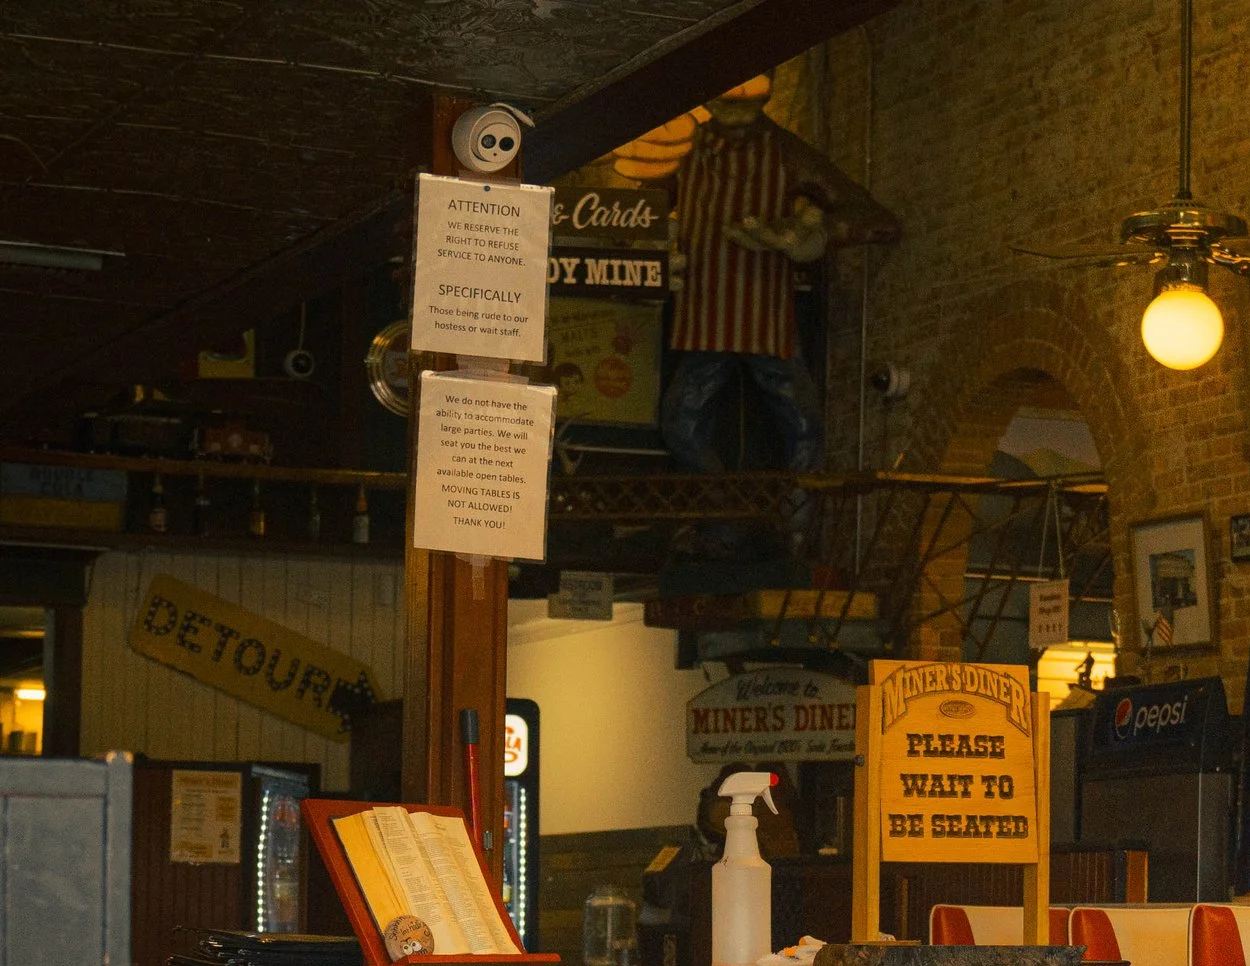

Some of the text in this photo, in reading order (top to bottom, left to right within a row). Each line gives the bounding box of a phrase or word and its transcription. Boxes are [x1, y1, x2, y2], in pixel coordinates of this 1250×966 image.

[448, 199, 520, 218] ATTENTION
[572, 192, 659, 230] Cards
[448, 221, 520, 236] WE RESERVE THE
[446, 236, 520, 251] RIGHT TO REFUSE
[438, 249, 526, 266] SERVICE TO ANYONE.
[585, 258, 662, 288] MINE
[438, 284, 522, 303] SPECIFICALLY
[429, 306, 454, 316] Those
[456, 308, 479, 320] being
[482, 312, 501, 320] rude
[503, 314, 512, 322] to
[434, 321, 466, 332] hostess
[480, 326, 498, 334] wait
[500, 328, 521, 336] staff.
[445, 395, 528, 411] We do not have the
[436, 410, 534, 426] ability to accommodate
[440, 424, 528, 440] large parties. We will
[440, 440, 526, 455] seat you the best we
[452, 456, 466, 464] can
[480, 457, 494, 466] the
[496, 460, 514, 468] next
[437, 468, 526, 484] available open tables.
[442, 484, 520, 500] MOVING TABLES IS
[448, 500, 512, 513] NOT ALLOWED!
[454, 516, 506, 529] THANK YOU!
[144, 594, 331, 708] DETOUR
[737, 675, 822, 700] Welcome to
[881, 663, 1031, 737] MINER'S DINER
[692, 702, 856, 734] MINER'S DINE
[1133, 695, 1188, 736] pepsi
[906, 734, 1006, 760] PLEASE
[900, 774, 1014, 800] WAIT TO
[888, 814, 1028, 839] BE SEATED
